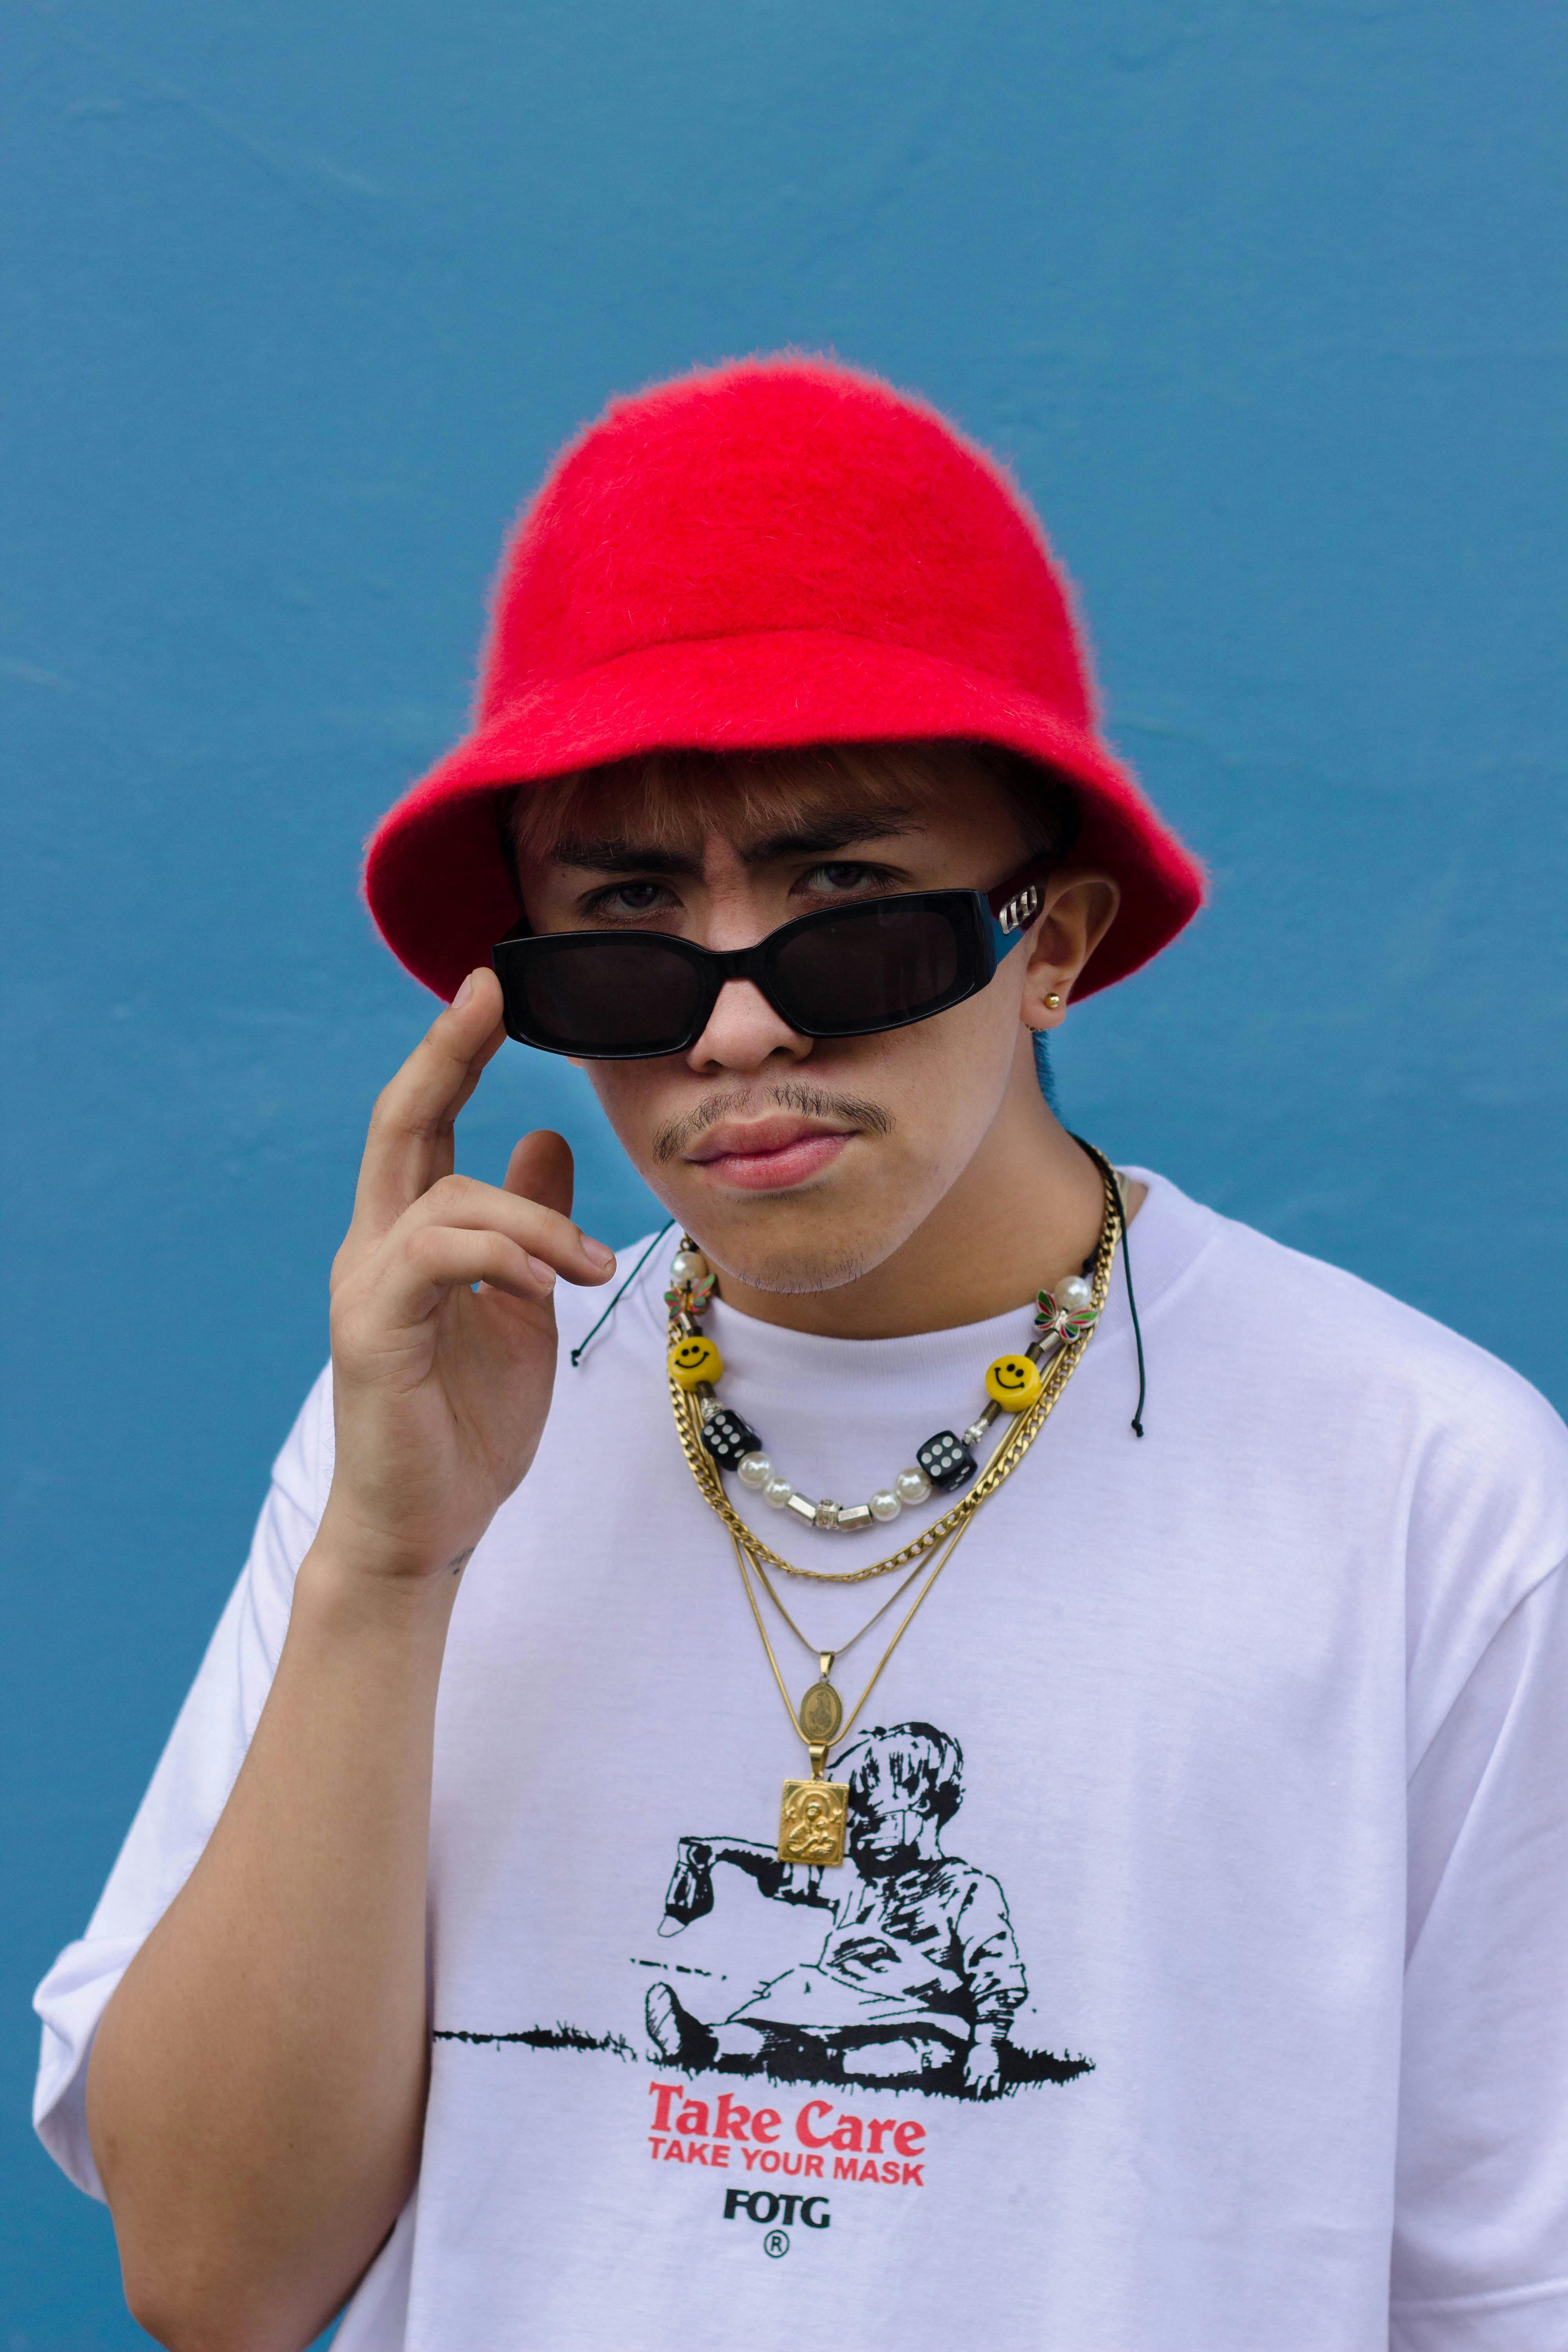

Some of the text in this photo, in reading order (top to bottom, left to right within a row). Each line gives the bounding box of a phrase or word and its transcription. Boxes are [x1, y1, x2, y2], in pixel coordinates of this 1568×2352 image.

[649, 2082, 926, 2157] Take Care
[648, 2136, 926, 2186] TAKE YOUR MASK
[723, 2189, 831, 2229] FOTG
